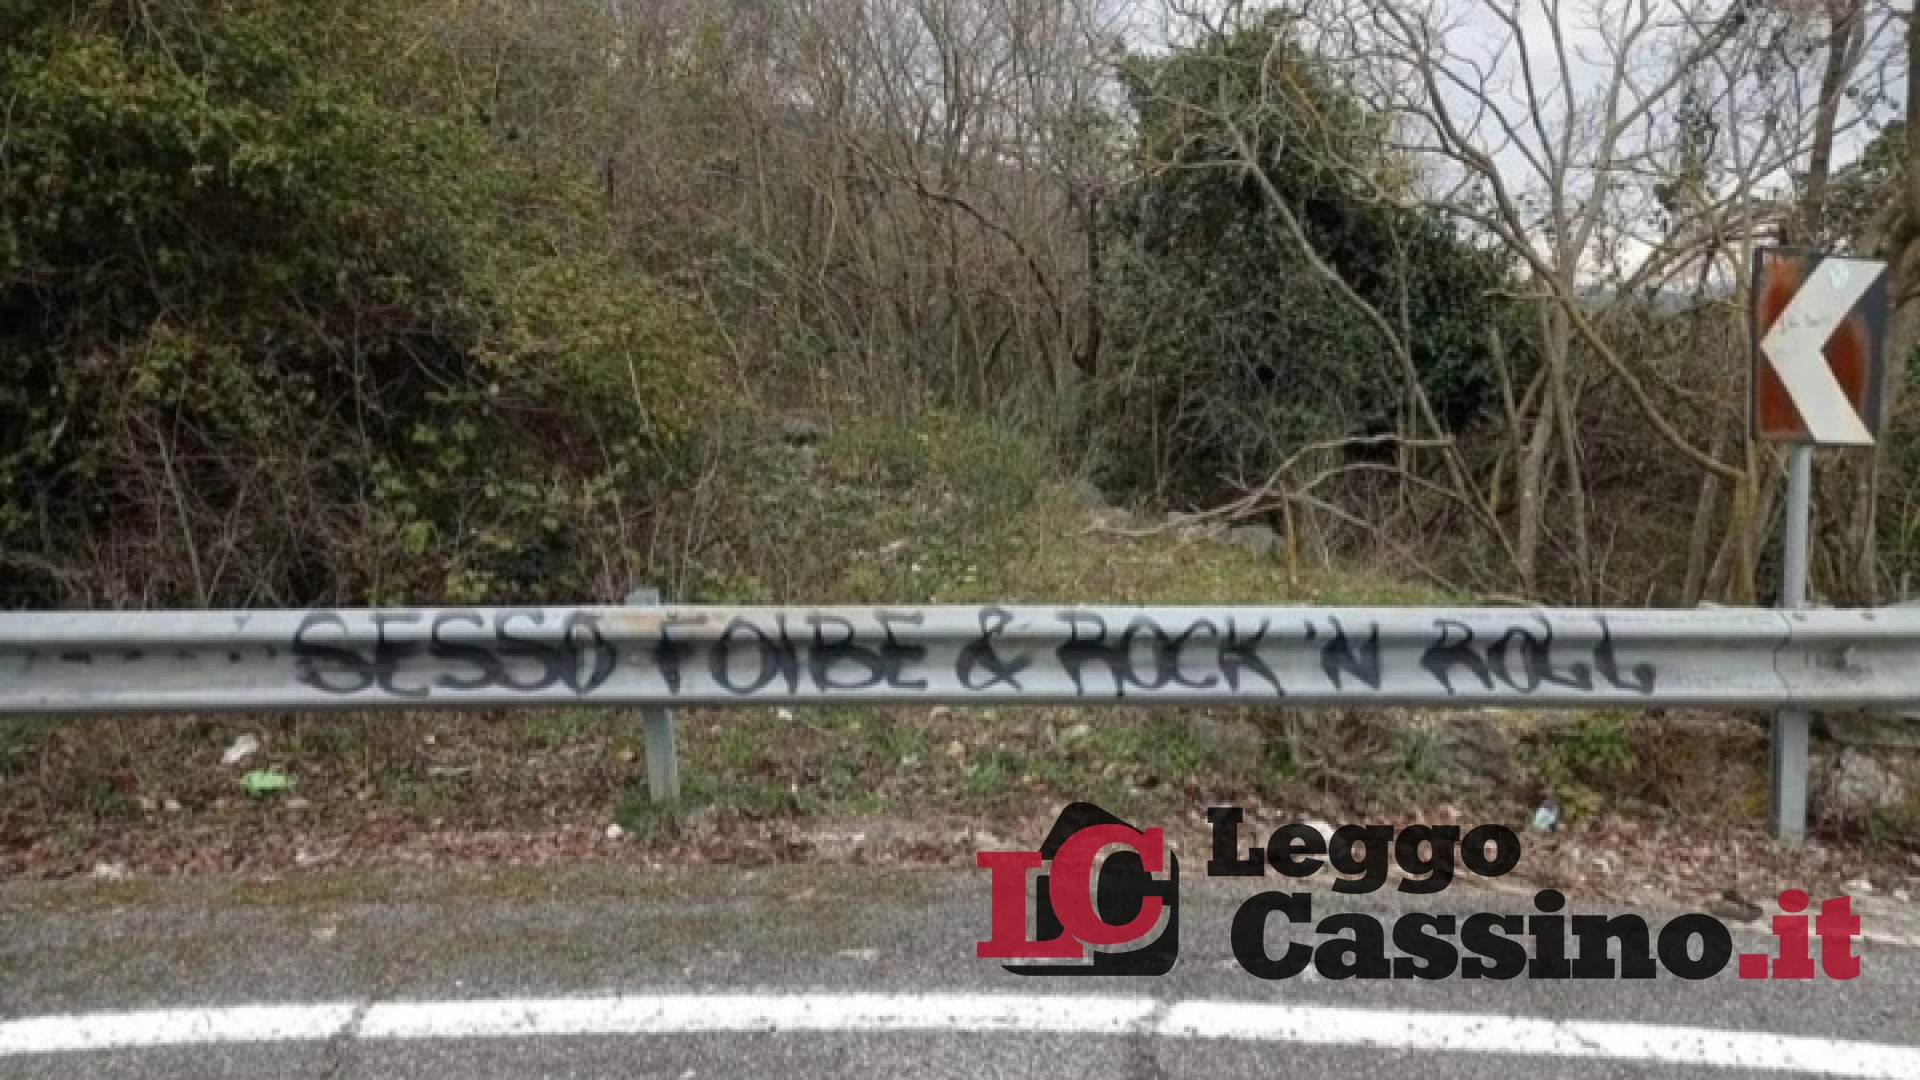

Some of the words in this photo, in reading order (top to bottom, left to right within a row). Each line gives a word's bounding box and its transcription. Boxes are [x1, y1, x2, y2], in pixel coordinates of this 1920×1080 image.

[293, 609, 618, 698] SESSO
[652, 610, 929, 696] FOIBE
[956, 606, 1032, 692] &
[1056, 609, 1285, 699] ROCK
[1419, 611, 1657, 696] ROLL
